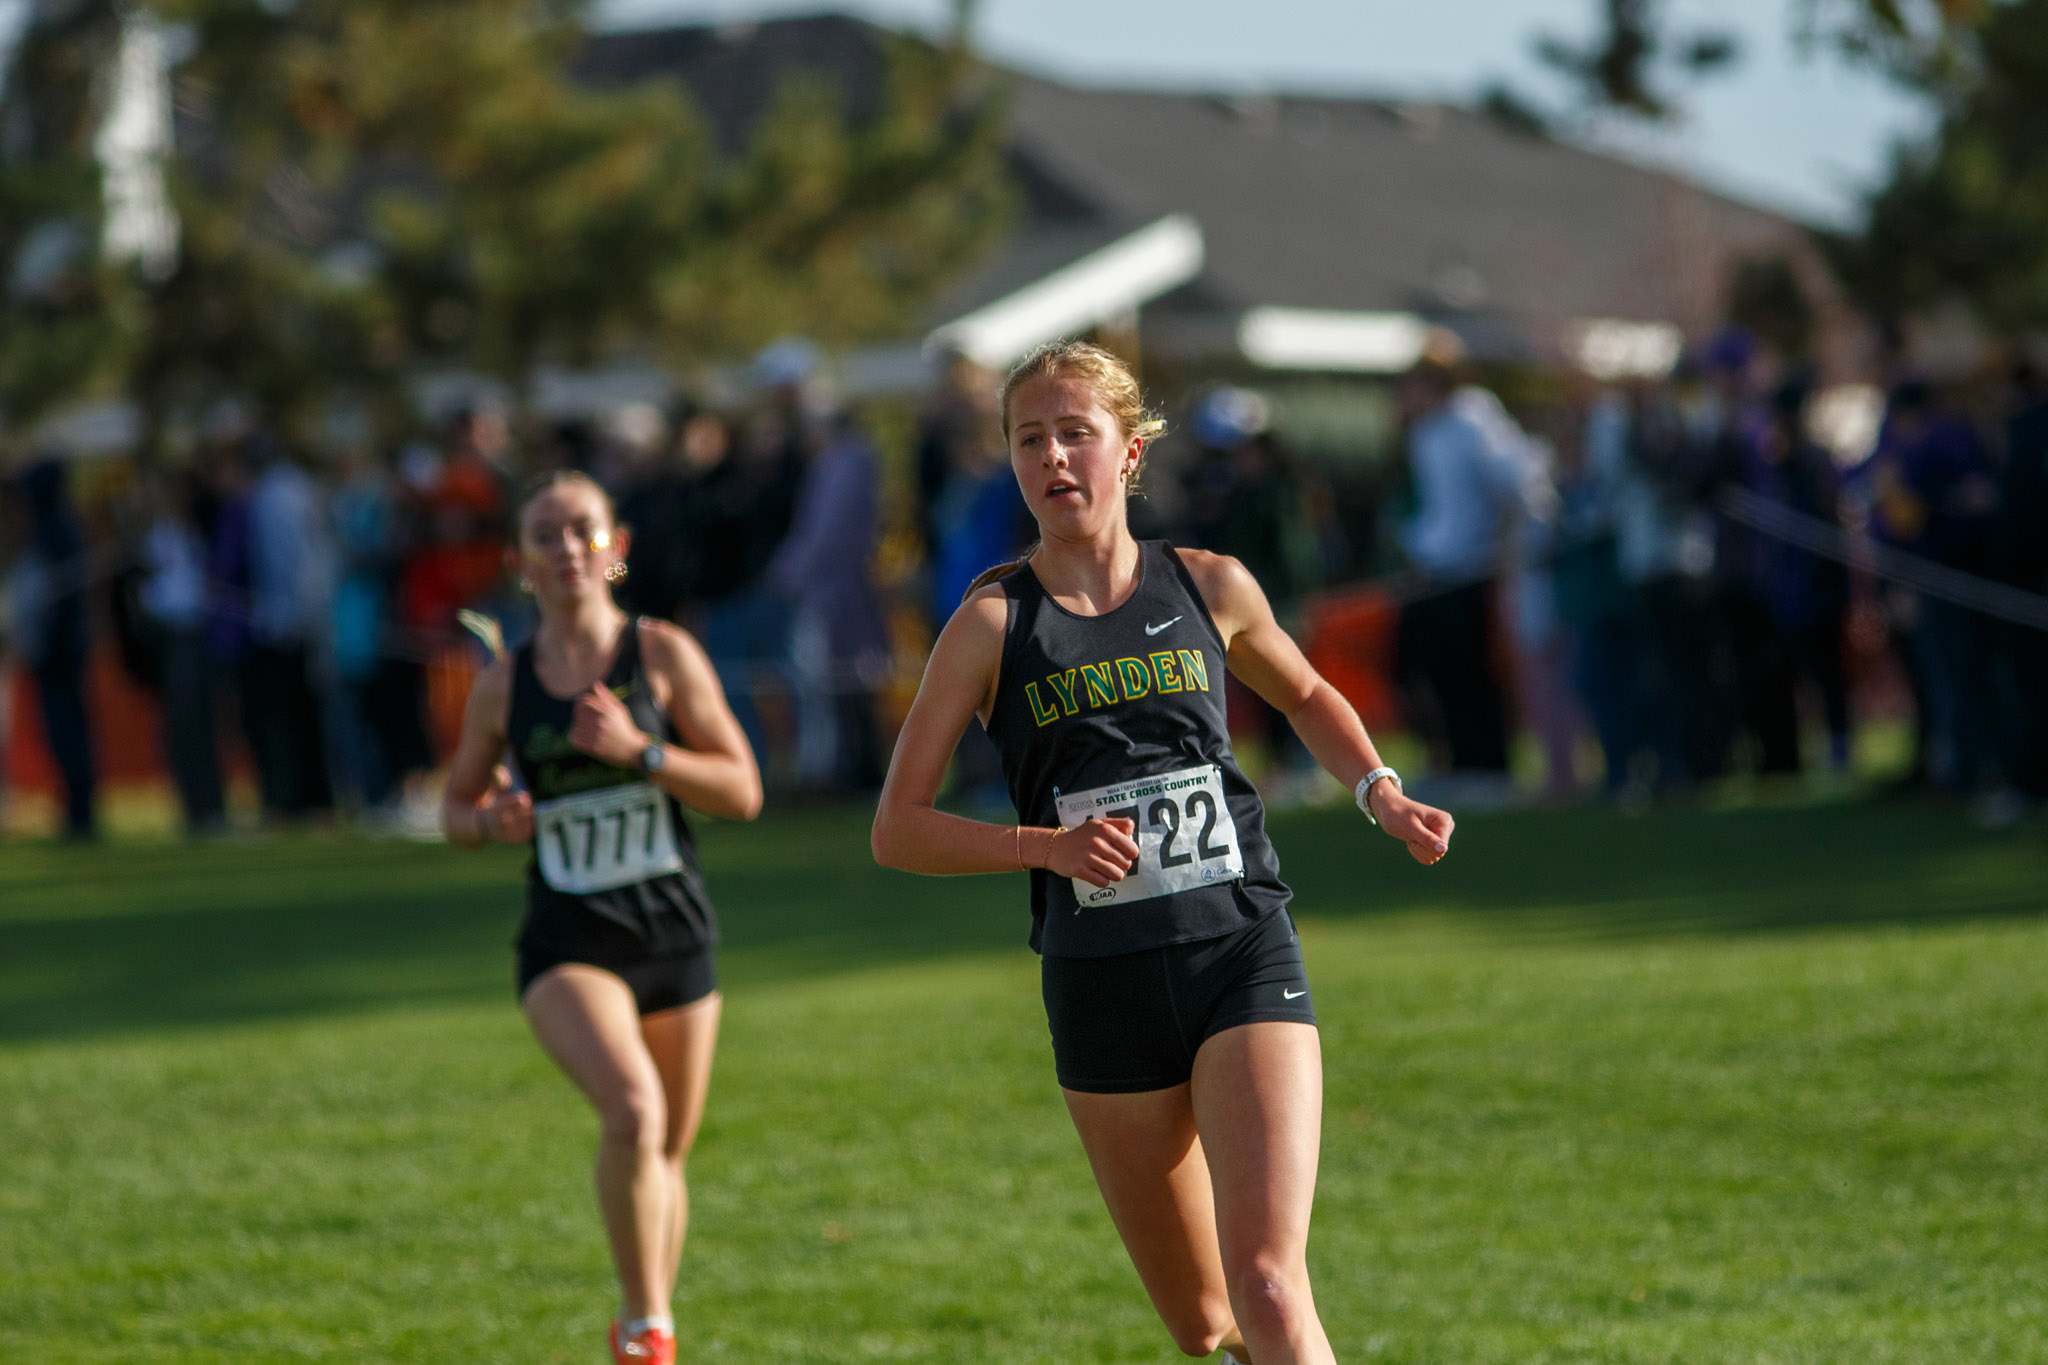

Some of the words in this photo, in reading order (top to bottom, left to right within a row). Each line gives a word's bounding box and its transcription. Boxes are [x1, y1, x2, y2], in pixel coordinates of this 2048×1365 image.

[1025, 649, 1209, 727] LYNDEN
[1096, 791, 1127, 807] STATE
[1129, 786, 1162, 799] CROSS
[1165, 775, 1208, 791] COUNTRY
[549, 803, 659, 870] 1777
[1085, 790, 1230, 877] 722
